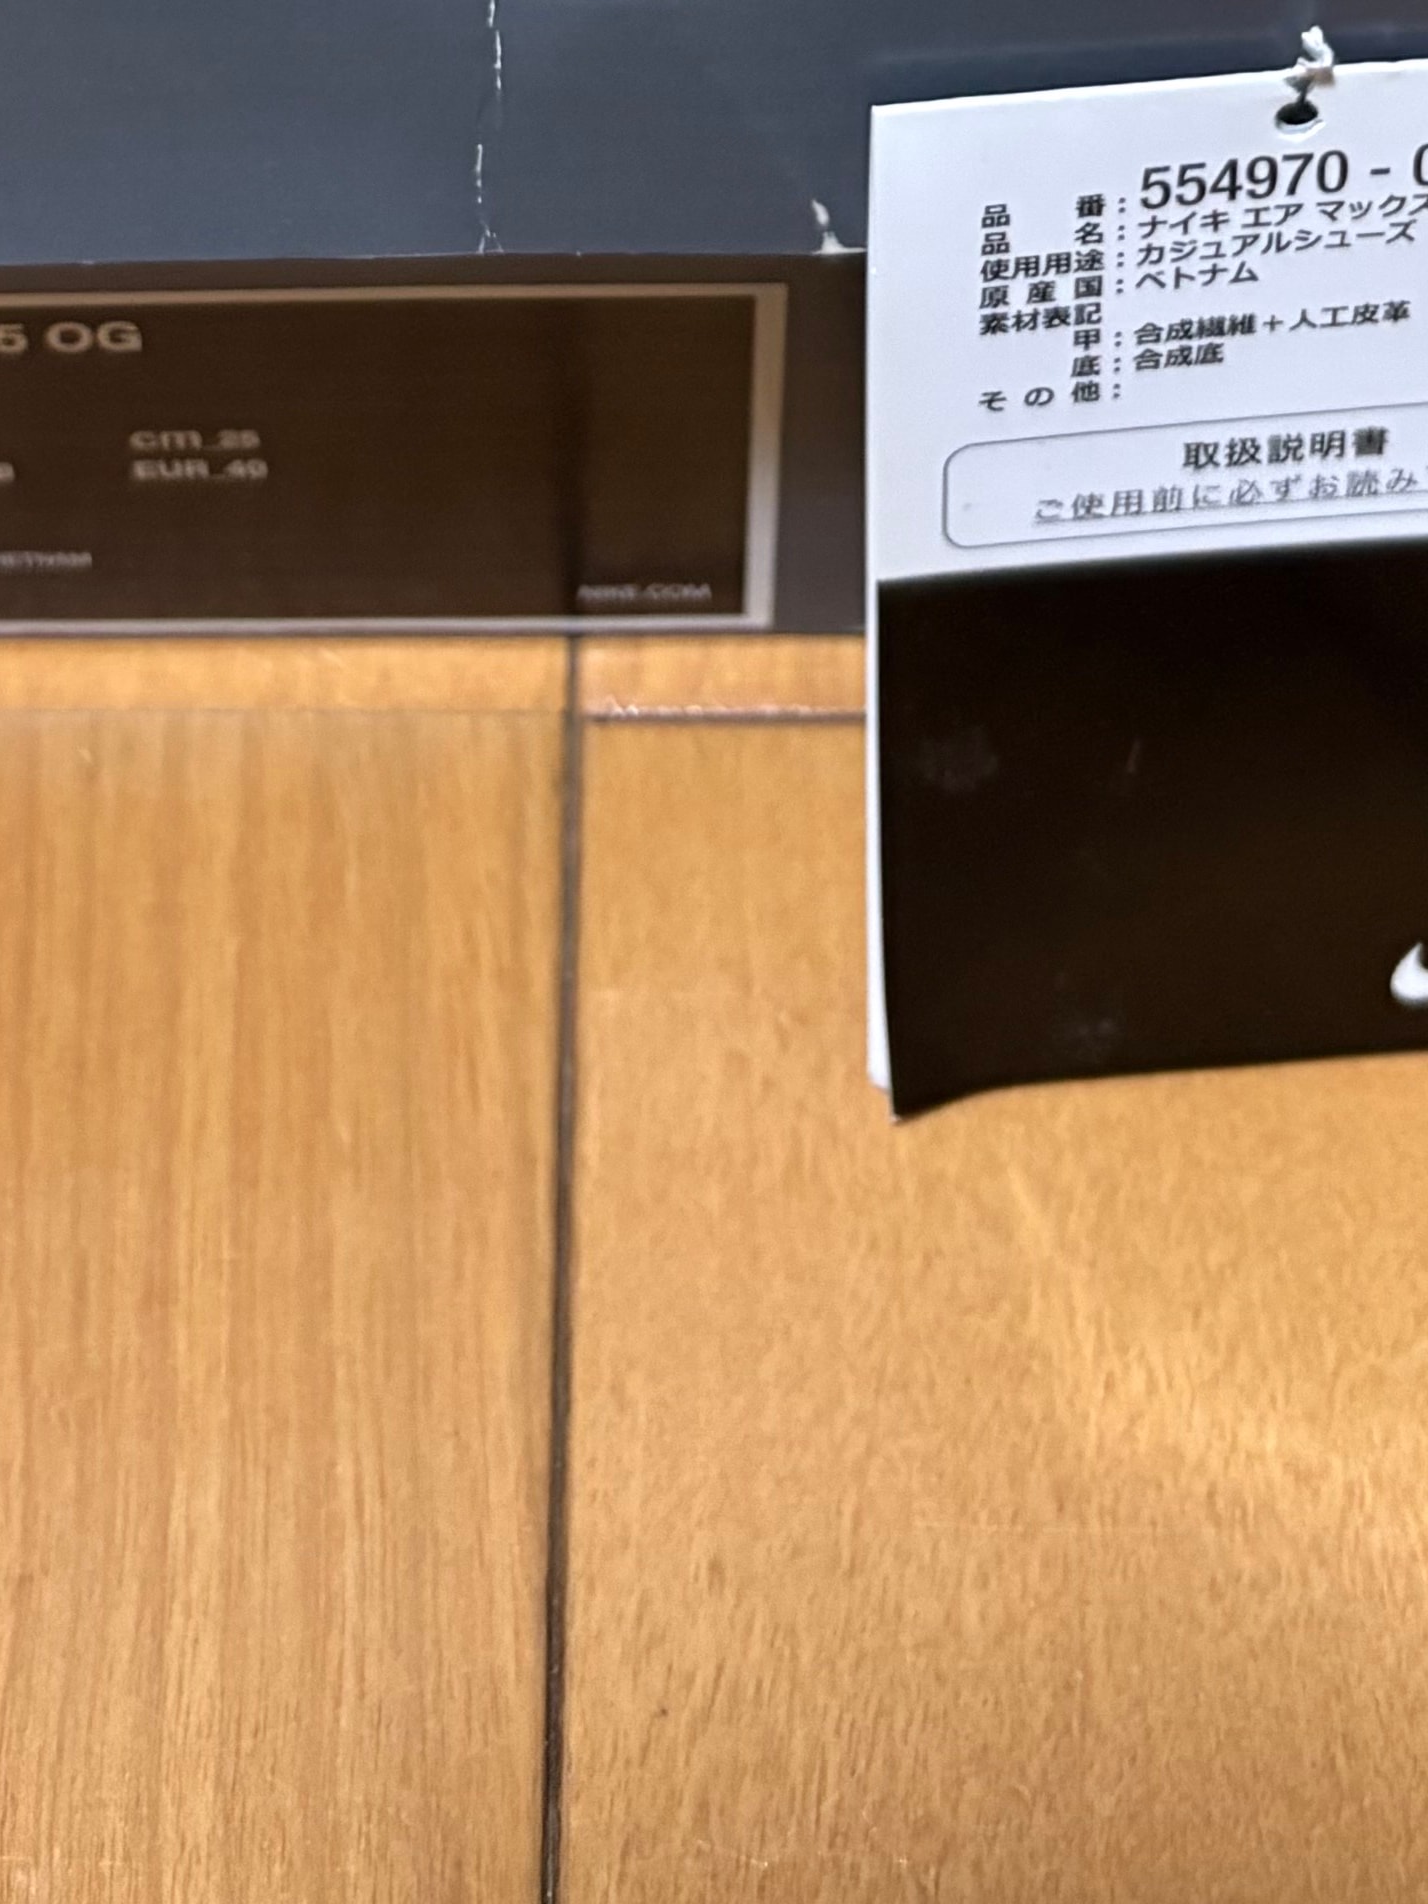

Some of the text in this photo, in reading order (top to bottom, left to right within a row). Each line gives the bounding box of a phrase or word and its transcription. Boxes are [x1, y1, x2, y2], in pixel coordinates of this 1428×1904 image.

[1139, 150, 1349, 209] 554970
[45, 321, 143, 353] OG
[1183, 426, 1388, 470] 取扱説明書
